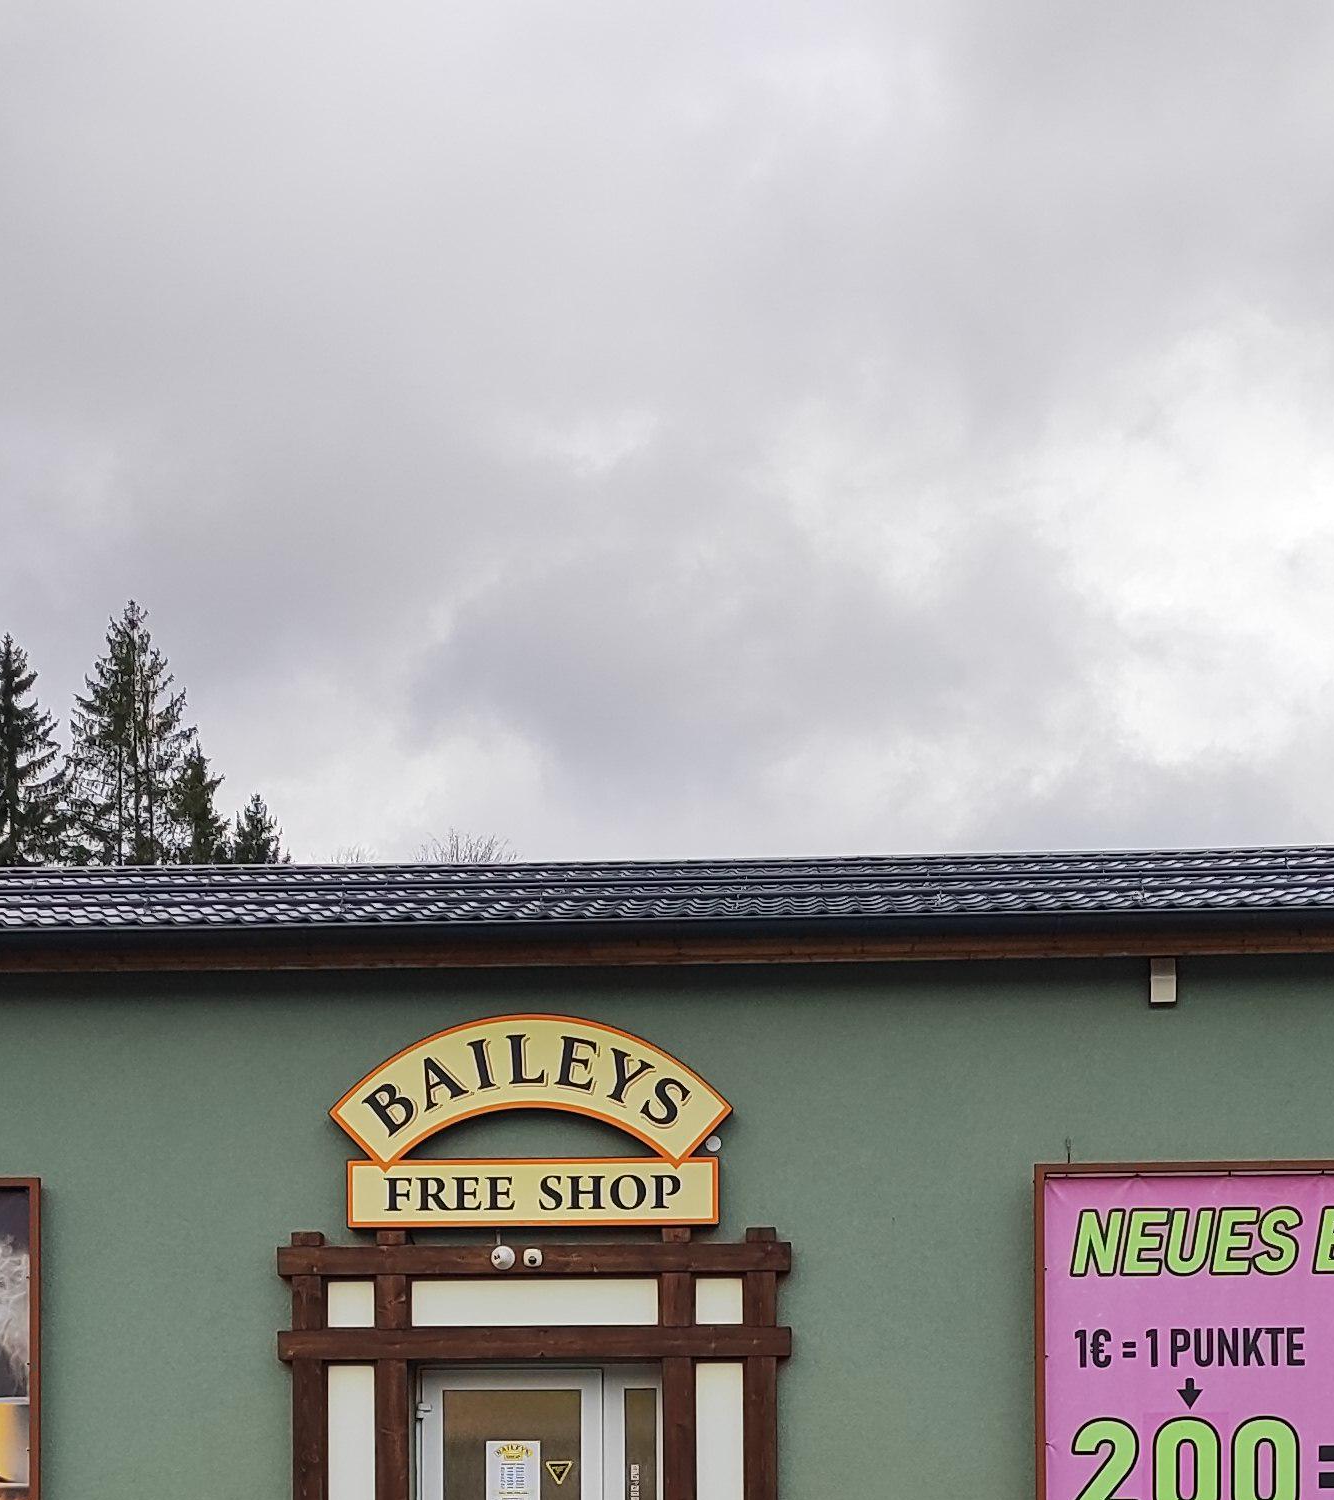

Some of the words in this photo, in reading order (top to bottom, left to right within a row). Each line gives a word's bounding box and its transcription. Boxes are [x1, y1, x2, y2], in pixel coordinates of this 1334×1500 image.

[362, 1033, 692, 1138] BAILEYS
[383, 1175, 516, 1213] FREE
[538, 1173, 683, 1212] SHOP
[1068, 1205, 1304, 1278] NEUES
[1073, 1328, 1112, 1369] 1€
[1169, 1326, 1306, 1368] PUNKTE
